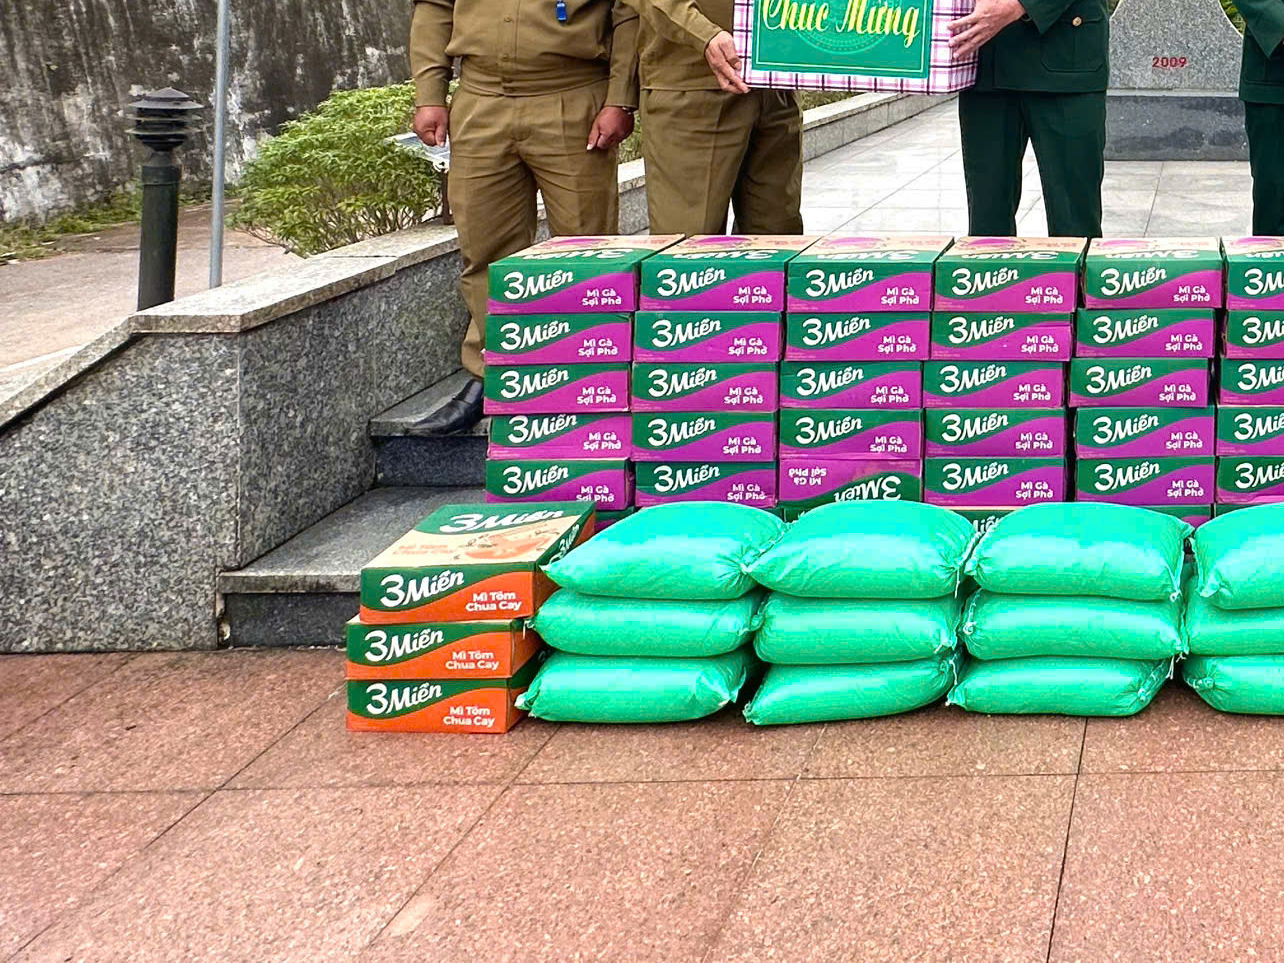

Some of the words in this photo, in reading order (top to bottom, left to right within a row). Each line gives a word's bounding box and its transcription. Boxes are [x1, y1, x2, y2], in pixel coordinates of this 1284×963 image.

[1152, 56, 1187, 69] 2009
[887, 287, 898, 295] Mì
[902, 287, 914, 295] Gà
[601, 296, 621, 305] Phở
[899, 295, 919, 304] Phở
[1191, 293, 1210, 301] Phở
[729, 387, 741, 395] Mì
[744, 387, 758, 395] Gà
[1019, 384, 1030, 392] Mì
[1033, 384, 1046, 392] Gà
[743, 395, 763, 403] Phở
[1032, 392, 1051, 400] Phở
[601, 440, 621, 449] Phở
[1035, 482, 1050, 490] Gà
[1034, 490, 1053, 498] Phở
[473, 591, 488, 602] Mì
[490, 591, 516, 600] Tôm
[465, 602, 497, 612] Chua
[499, 600, 521, 611] Cay
[452, 651, 466, 660] Mì
[468, 651, 494, 659] Tôm
[445, 660, 475, 669] Chua
[477, 660, 499, 670] Cay
[450, 706, 463, 715] Mì
[465, 706, 490, 715] Tôm
[443, 716, 472, 725] Chua
[474, 716, 495, 727] Cay
